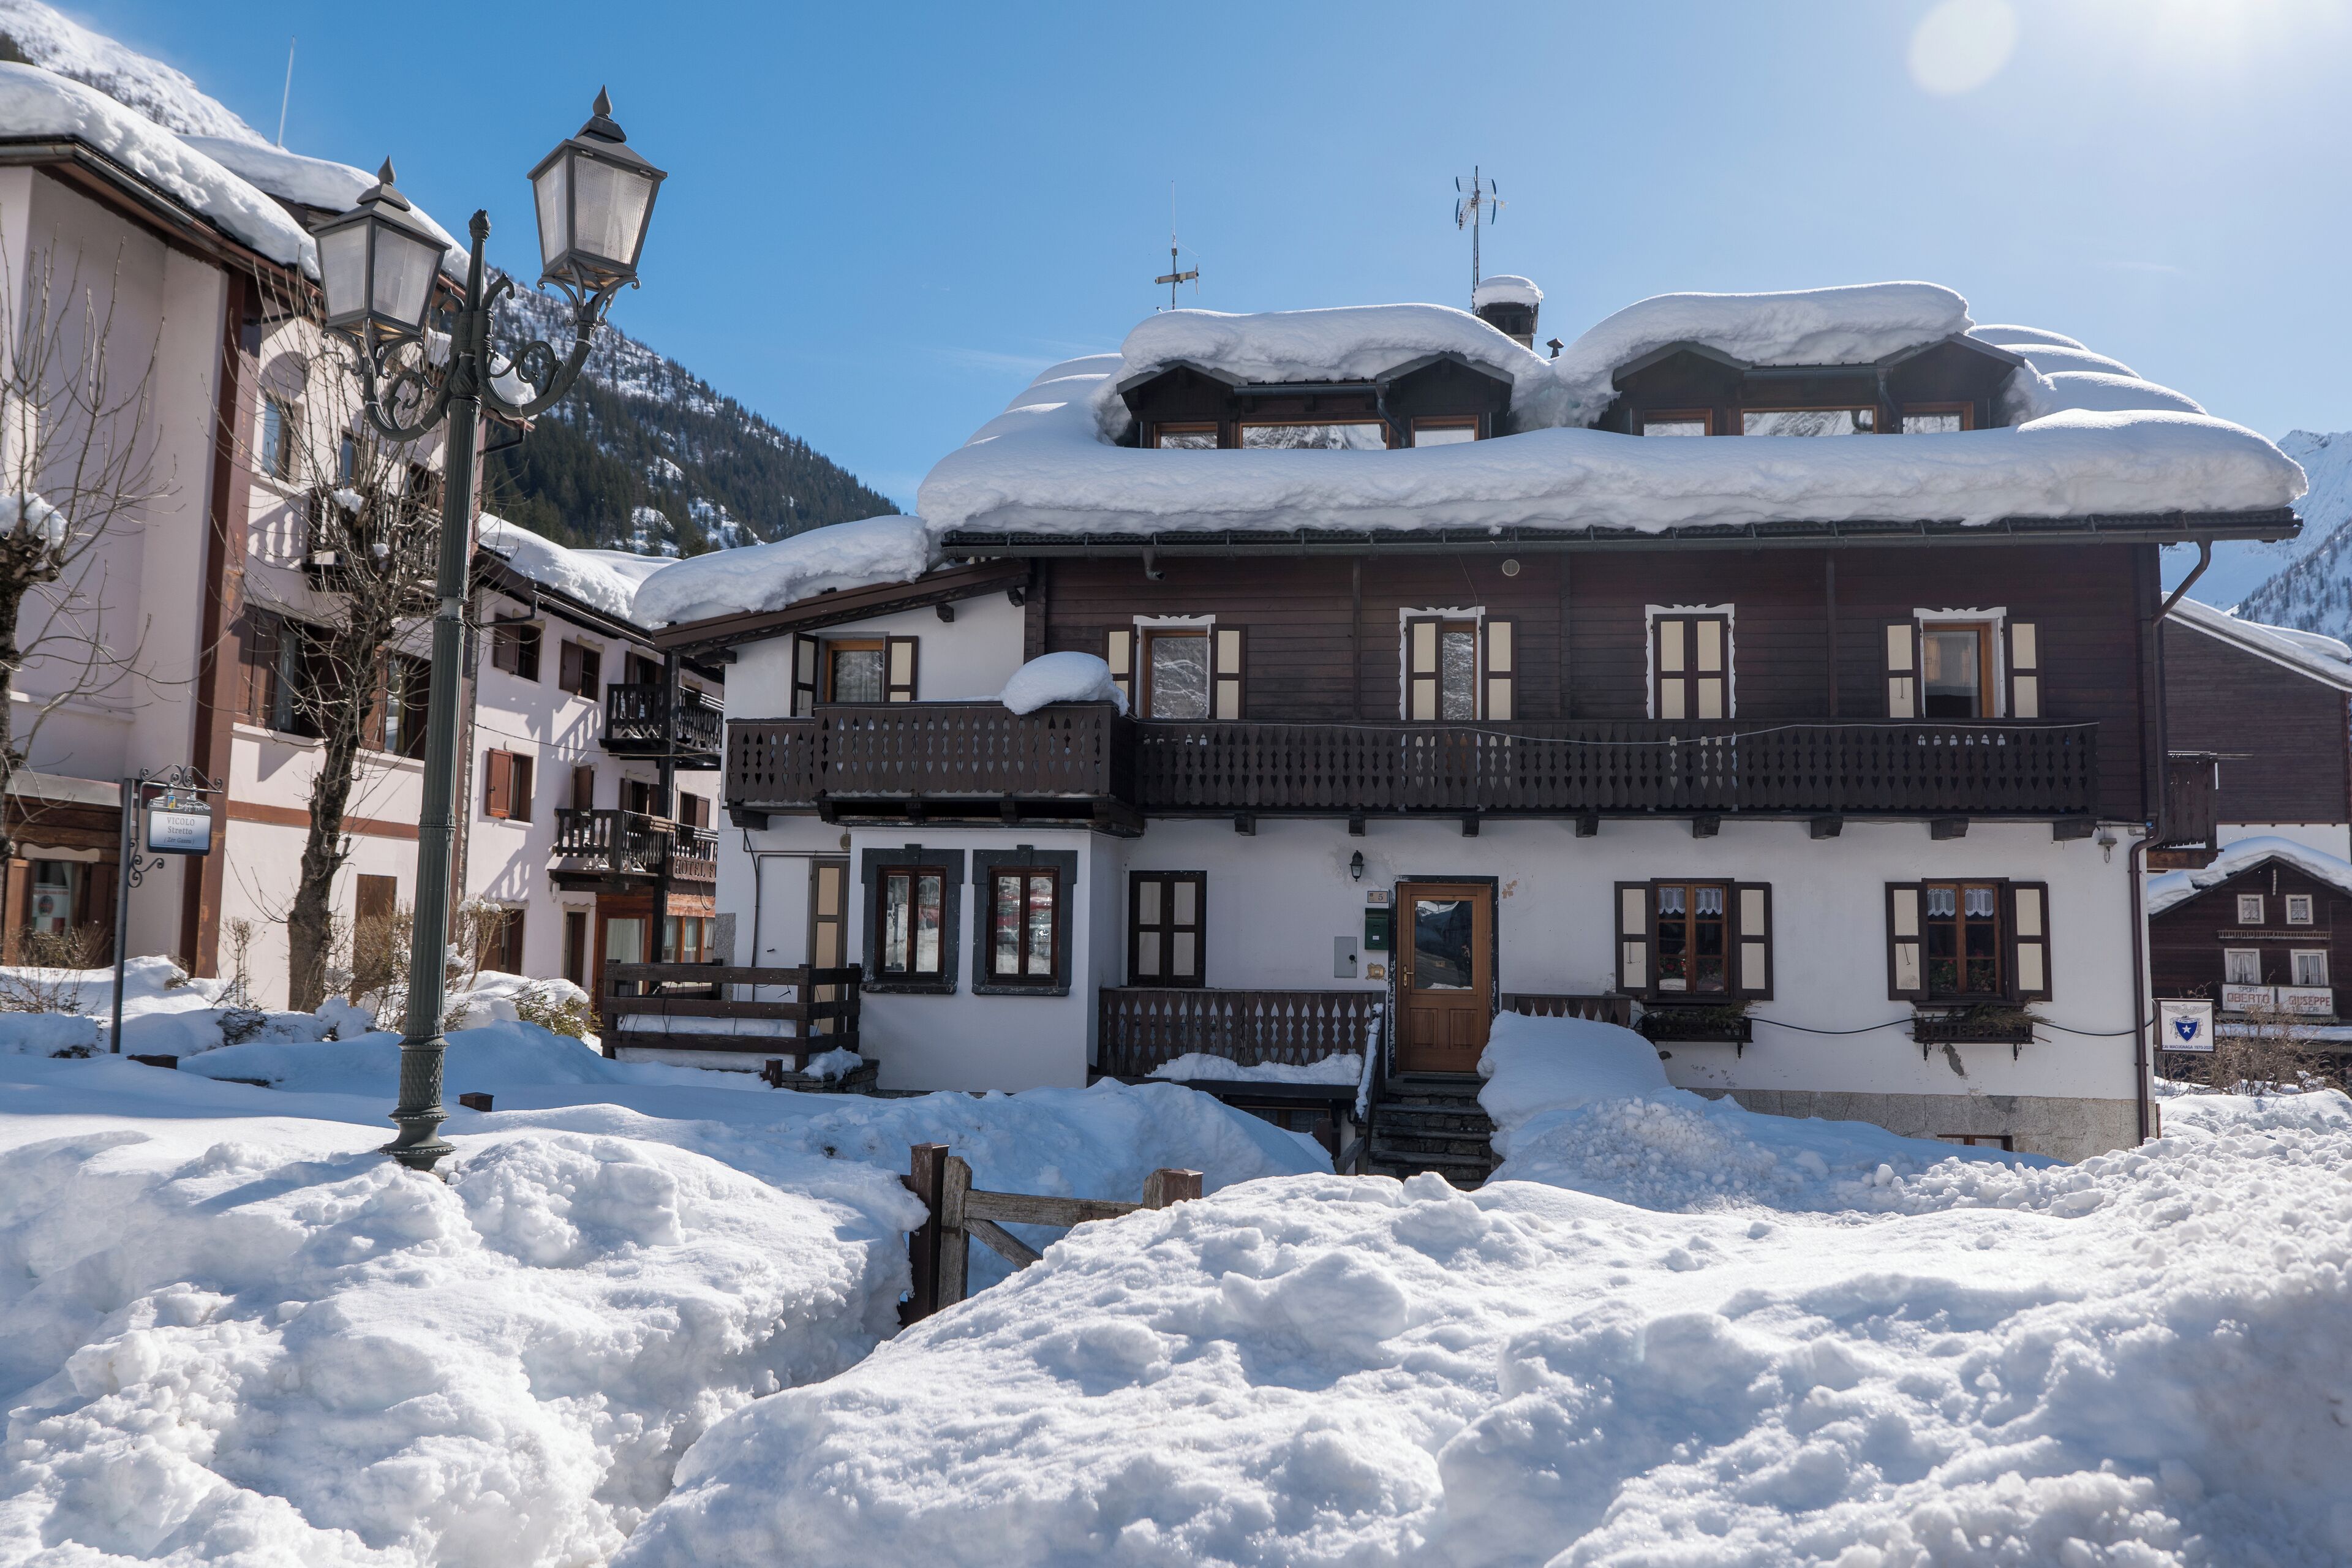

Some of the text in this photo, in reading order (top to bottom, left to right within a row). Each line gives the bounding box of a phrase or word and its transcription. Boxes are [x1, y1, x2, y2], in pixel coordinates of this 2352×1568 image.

[167, 817, 195, 826] VICOLO
[167, 826, 192, 835] Stretto
[676, 859, 717, 878] HOTEL F
[2227, 992, 2331, 1006] OBERTO GIUSEPPE
